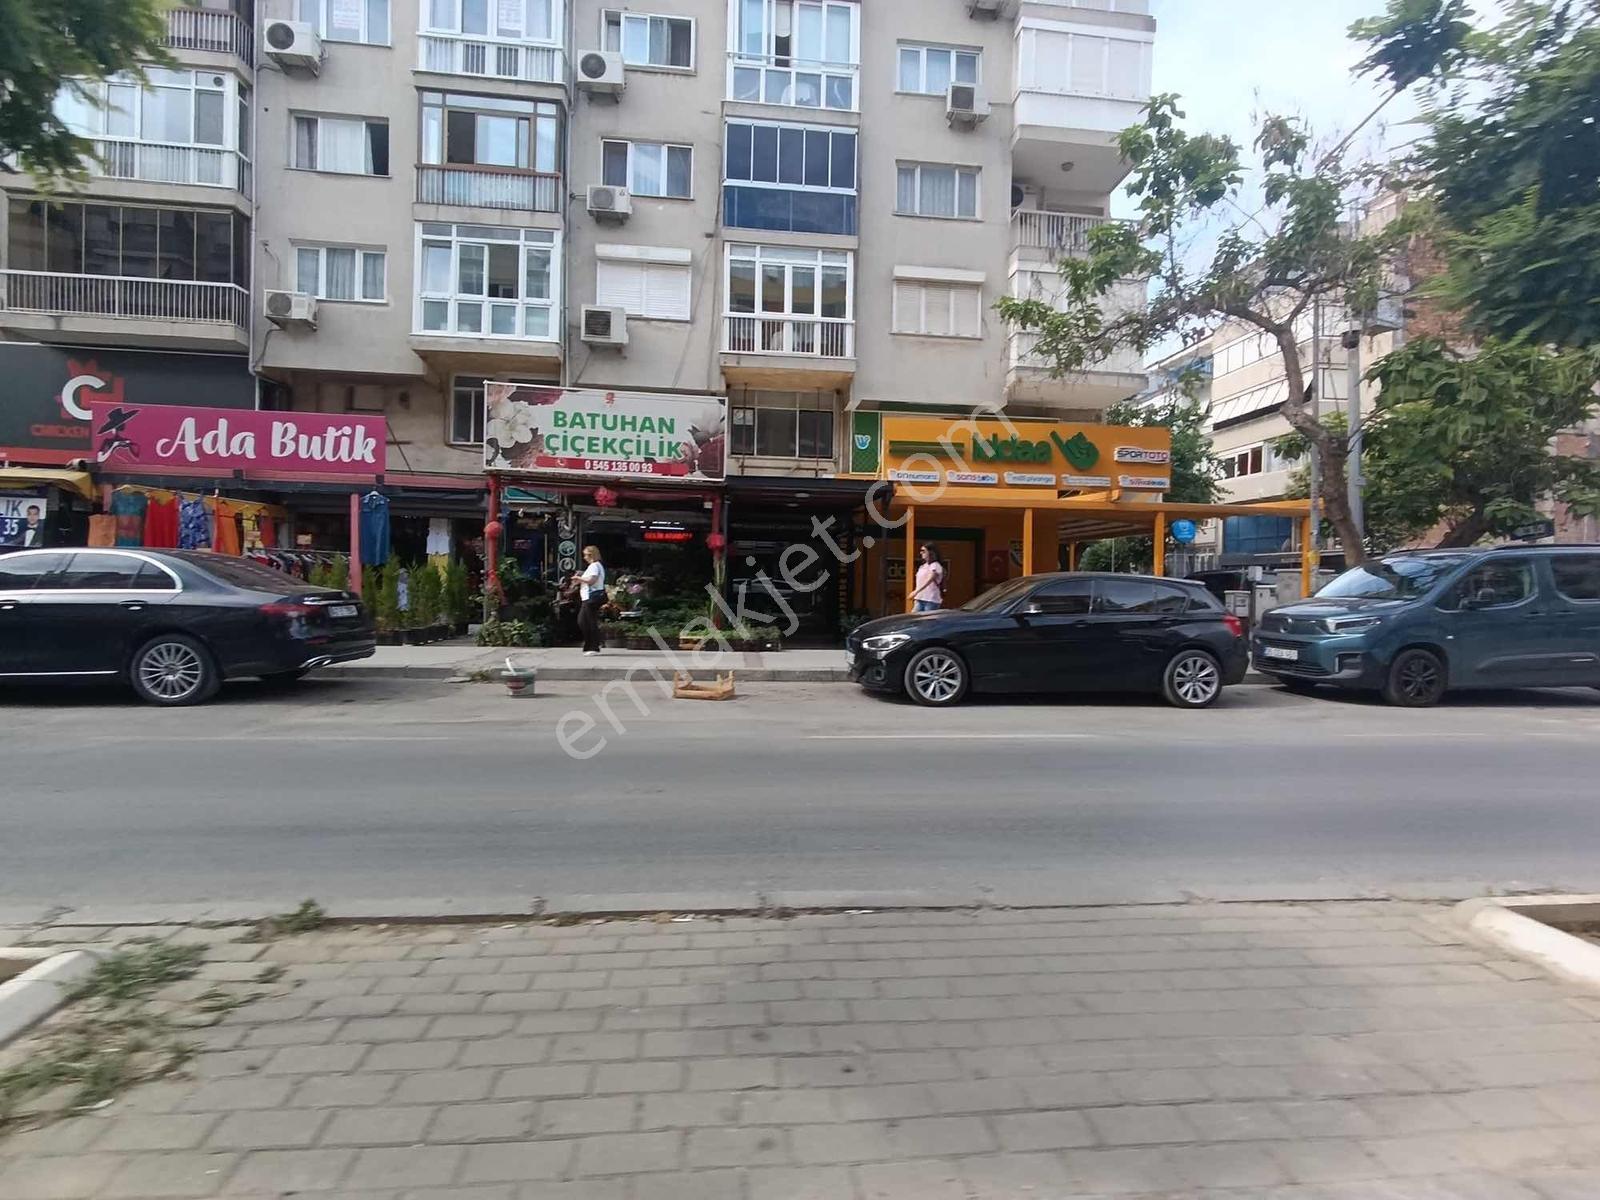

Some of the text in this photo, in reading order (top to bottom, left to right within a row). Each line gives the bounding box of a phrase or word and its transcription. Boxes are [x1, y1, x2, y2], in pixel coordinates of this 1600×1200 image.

[553, 410, 675, 434] BATUHAN
[156, 417, 377, 464] Ada Butik
[545, 431, 683, 459] ÇİÇEKÇİLİK
[584, 460, 591, 470] 0
[628, 462, 641, 472] 00
[641, 463, 653, 473] 93
